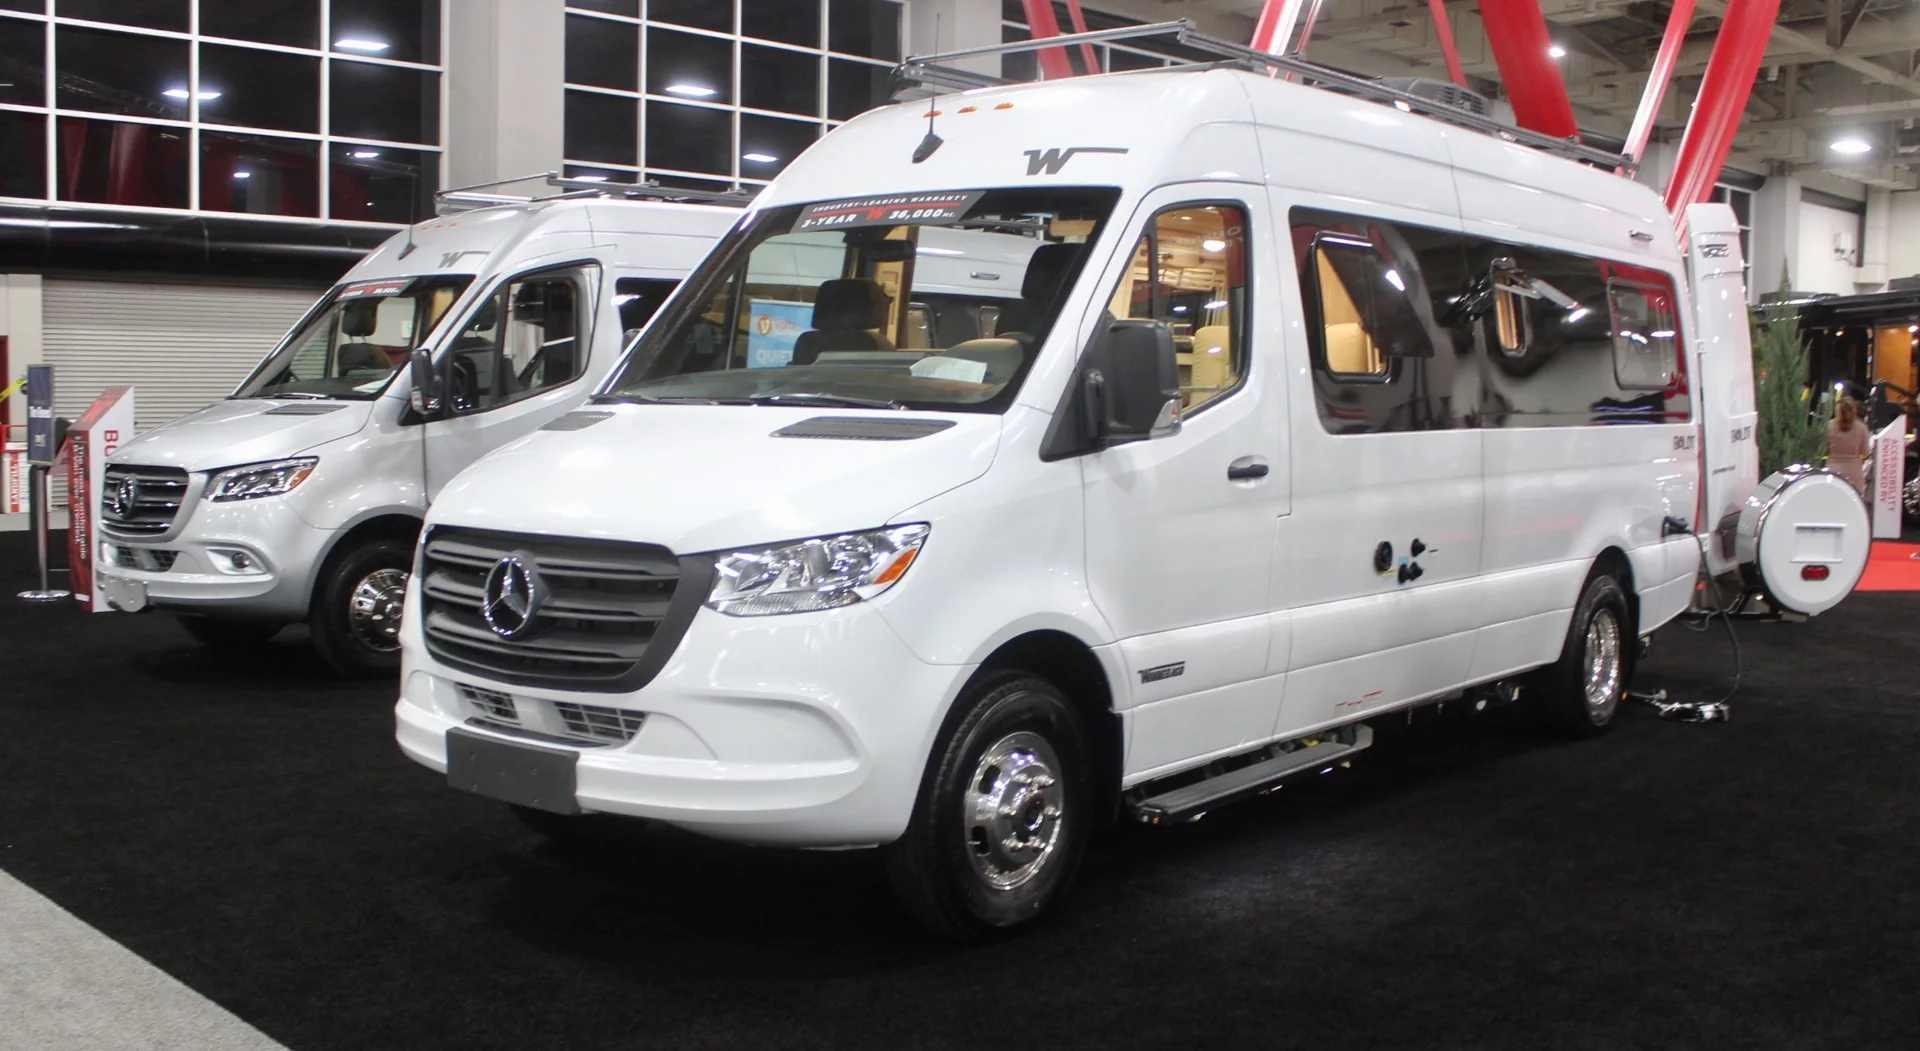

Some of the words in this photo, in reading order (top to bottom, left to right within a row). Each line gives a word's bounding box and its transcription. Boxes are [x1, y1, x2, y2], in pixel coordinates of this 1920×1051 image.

[812, 197, 907, 213] INDUSTRY-LEADING
[910, 195, 968, 203] WARRANTY
[801, 213, 857, 229] 3-YEAR
[1880, 438, 1890, 489] ENHANCED
[1887, 439, 1898, 512] ACCESSIBILITY
[1880, 491, 1888, 503] RV
